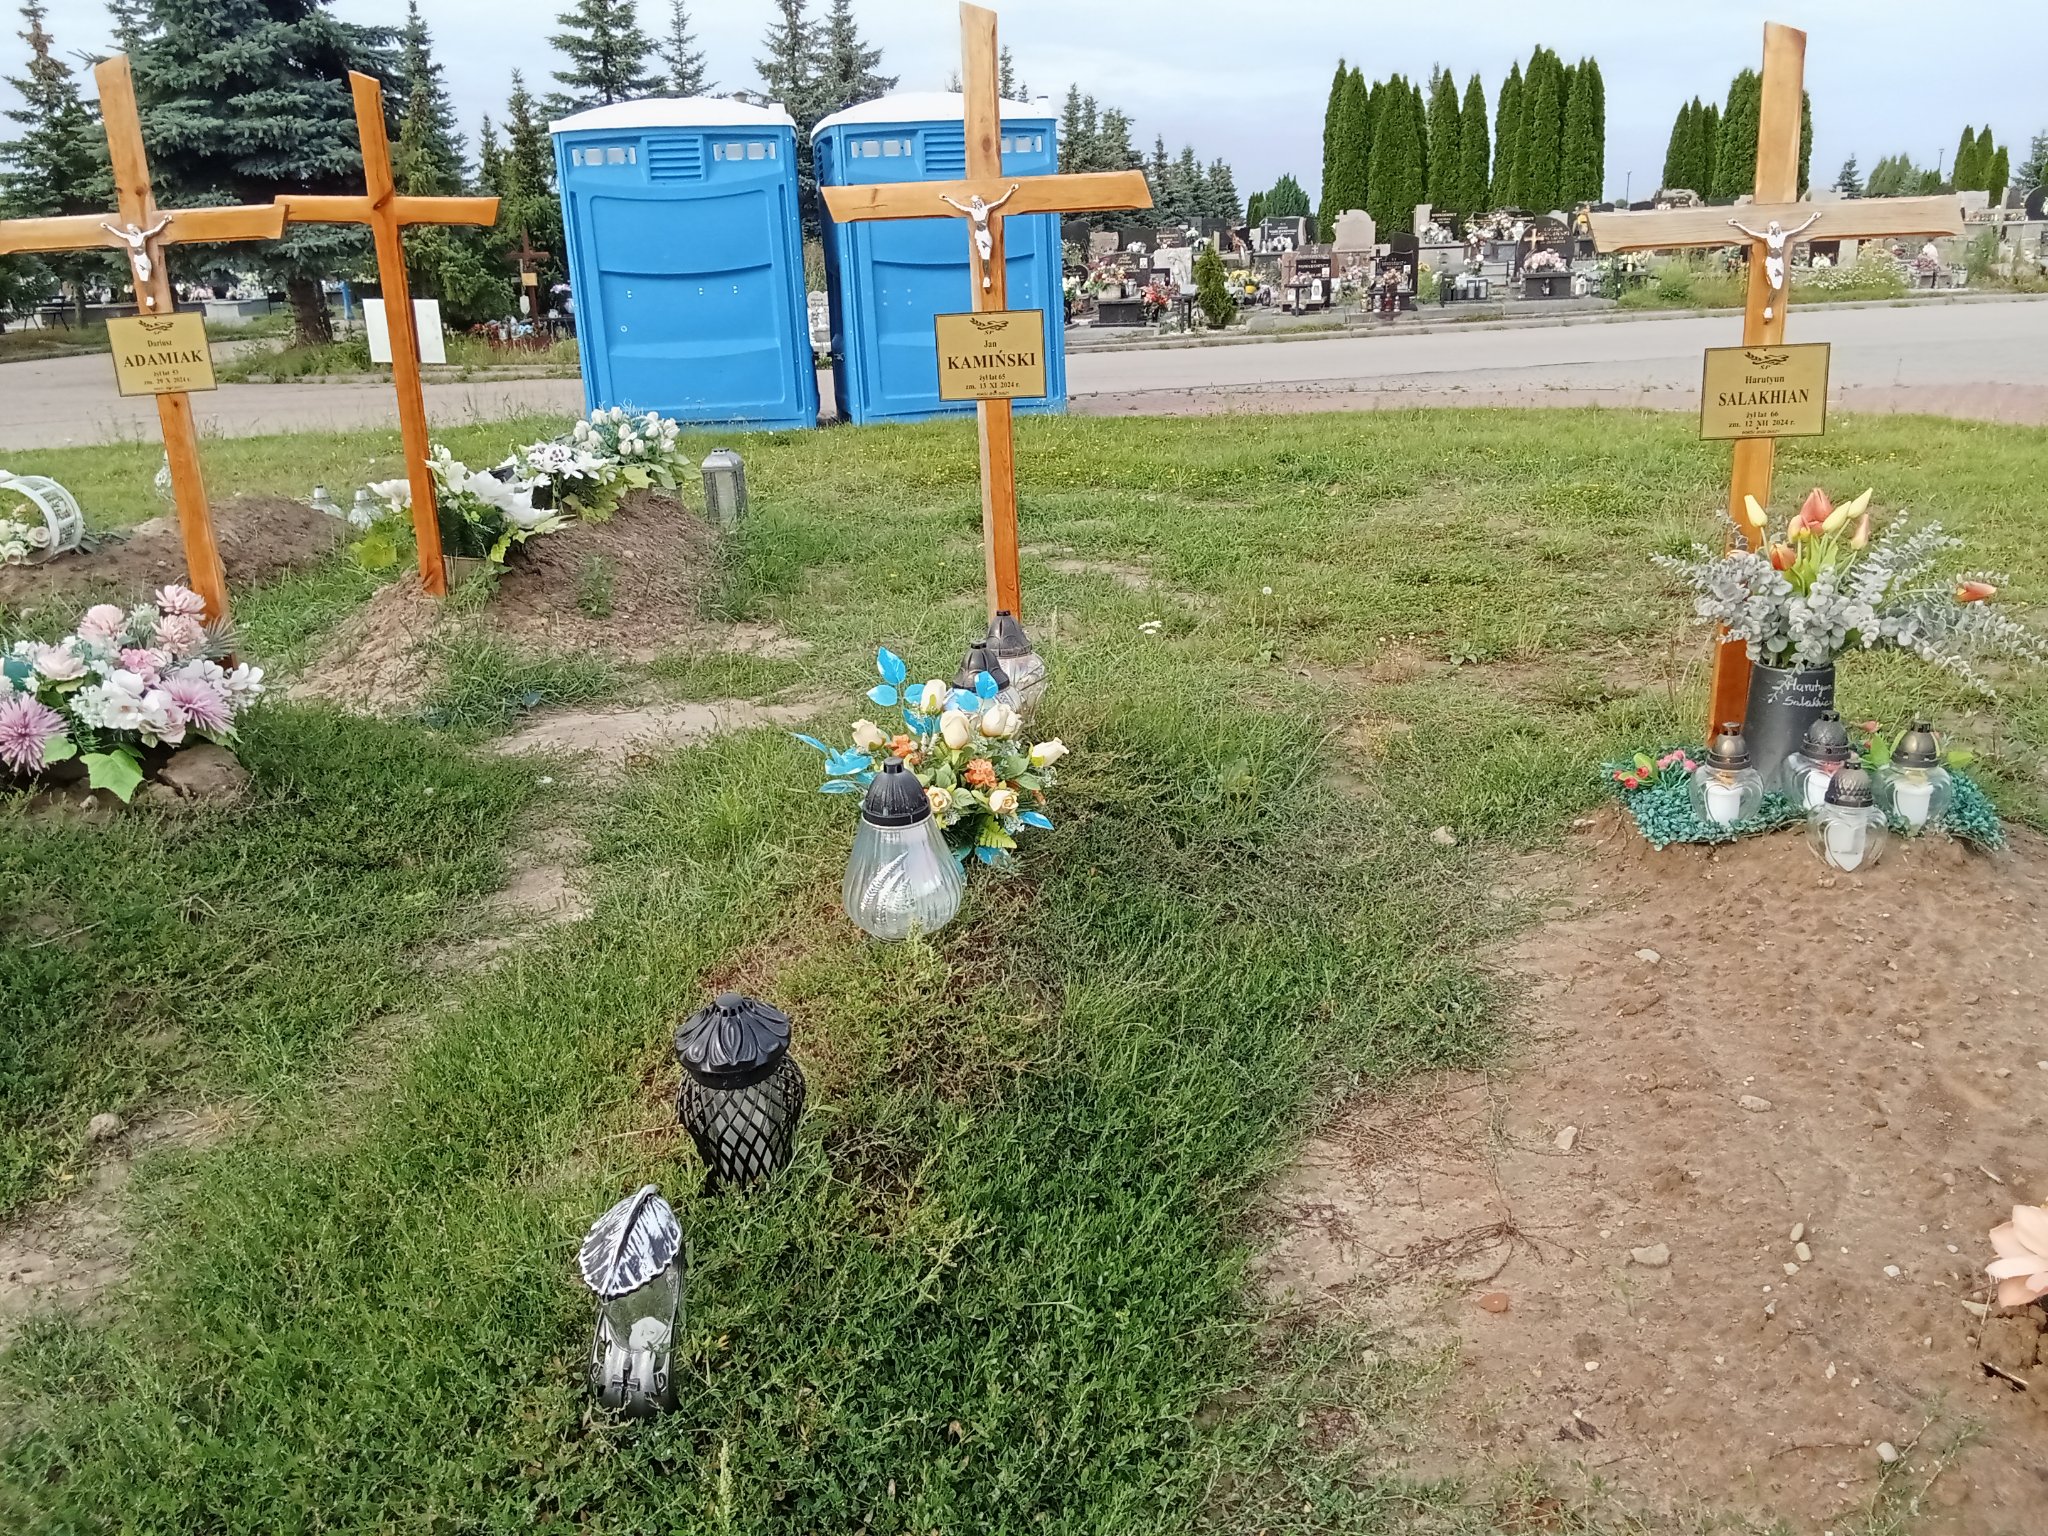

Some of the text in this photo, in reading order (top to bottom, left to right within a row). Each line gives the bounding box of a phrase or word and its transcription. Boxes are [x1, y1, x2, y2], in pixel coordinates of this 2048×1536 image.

[147, 339, 172, 348] Dariusz
[983, 340, 997, 348] Jan
[124, 350, 204, 367] ADAMIAK
[947, 350, 1036, 370] KAMIŃSKI
[1745, 375, 1785, 385] Harutyun
[1718, 389, 1810, 406] SALAKHIAN
